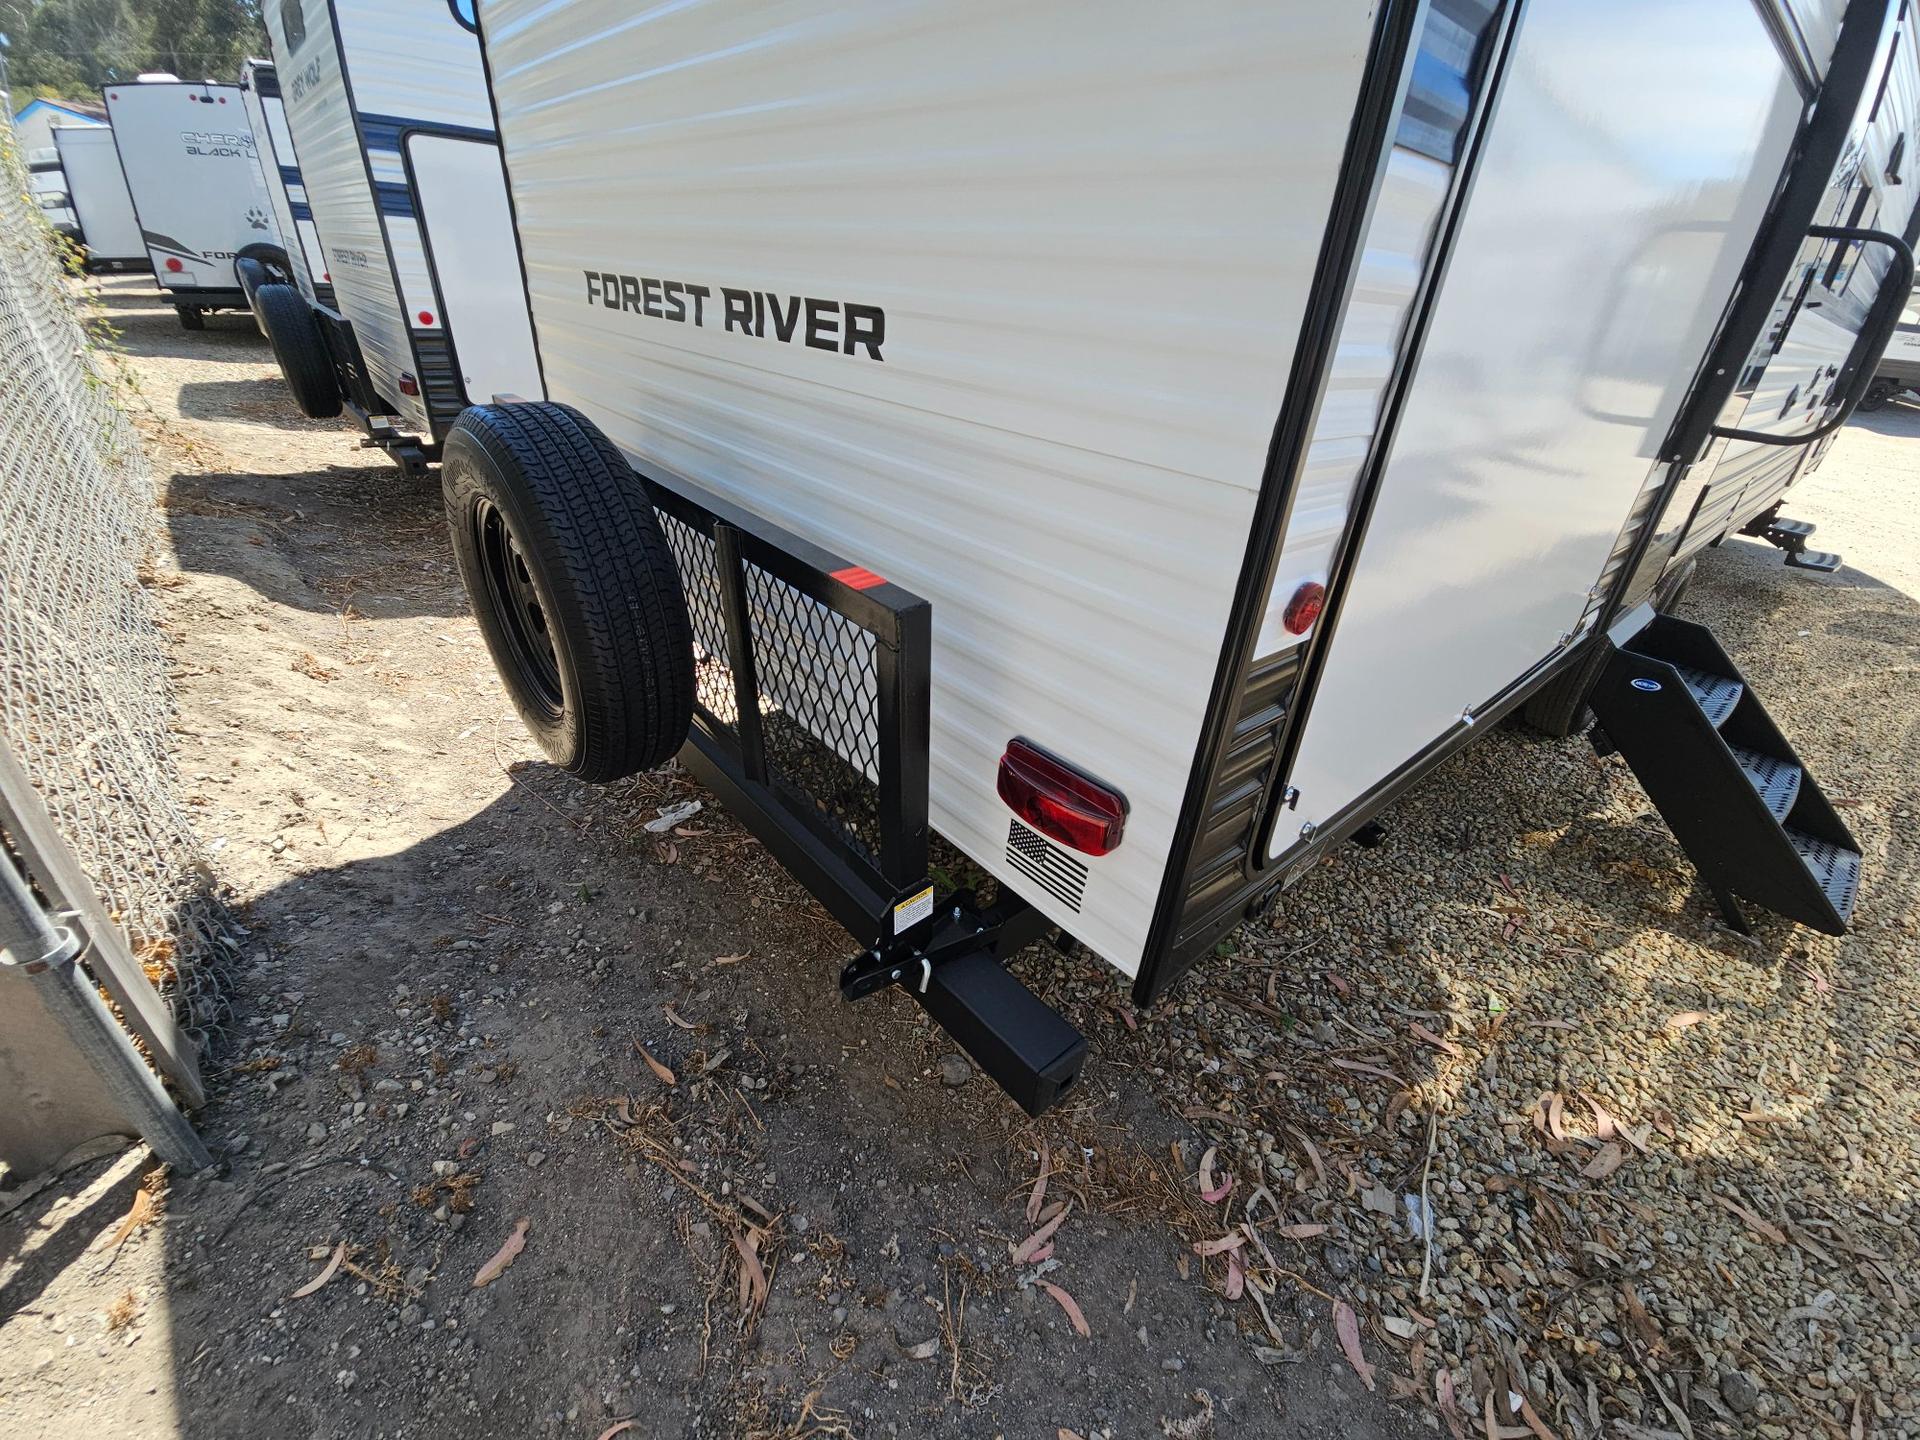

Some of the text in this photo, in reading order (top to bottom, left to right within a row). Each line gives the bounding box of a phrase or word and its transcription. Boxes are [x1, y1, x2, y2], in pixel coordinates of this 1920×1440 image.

[186, 146, 241, 157] BLACK
[202, 251, 238, 260] FOR
[583, 270, 886, 362] FOREST RIVER
